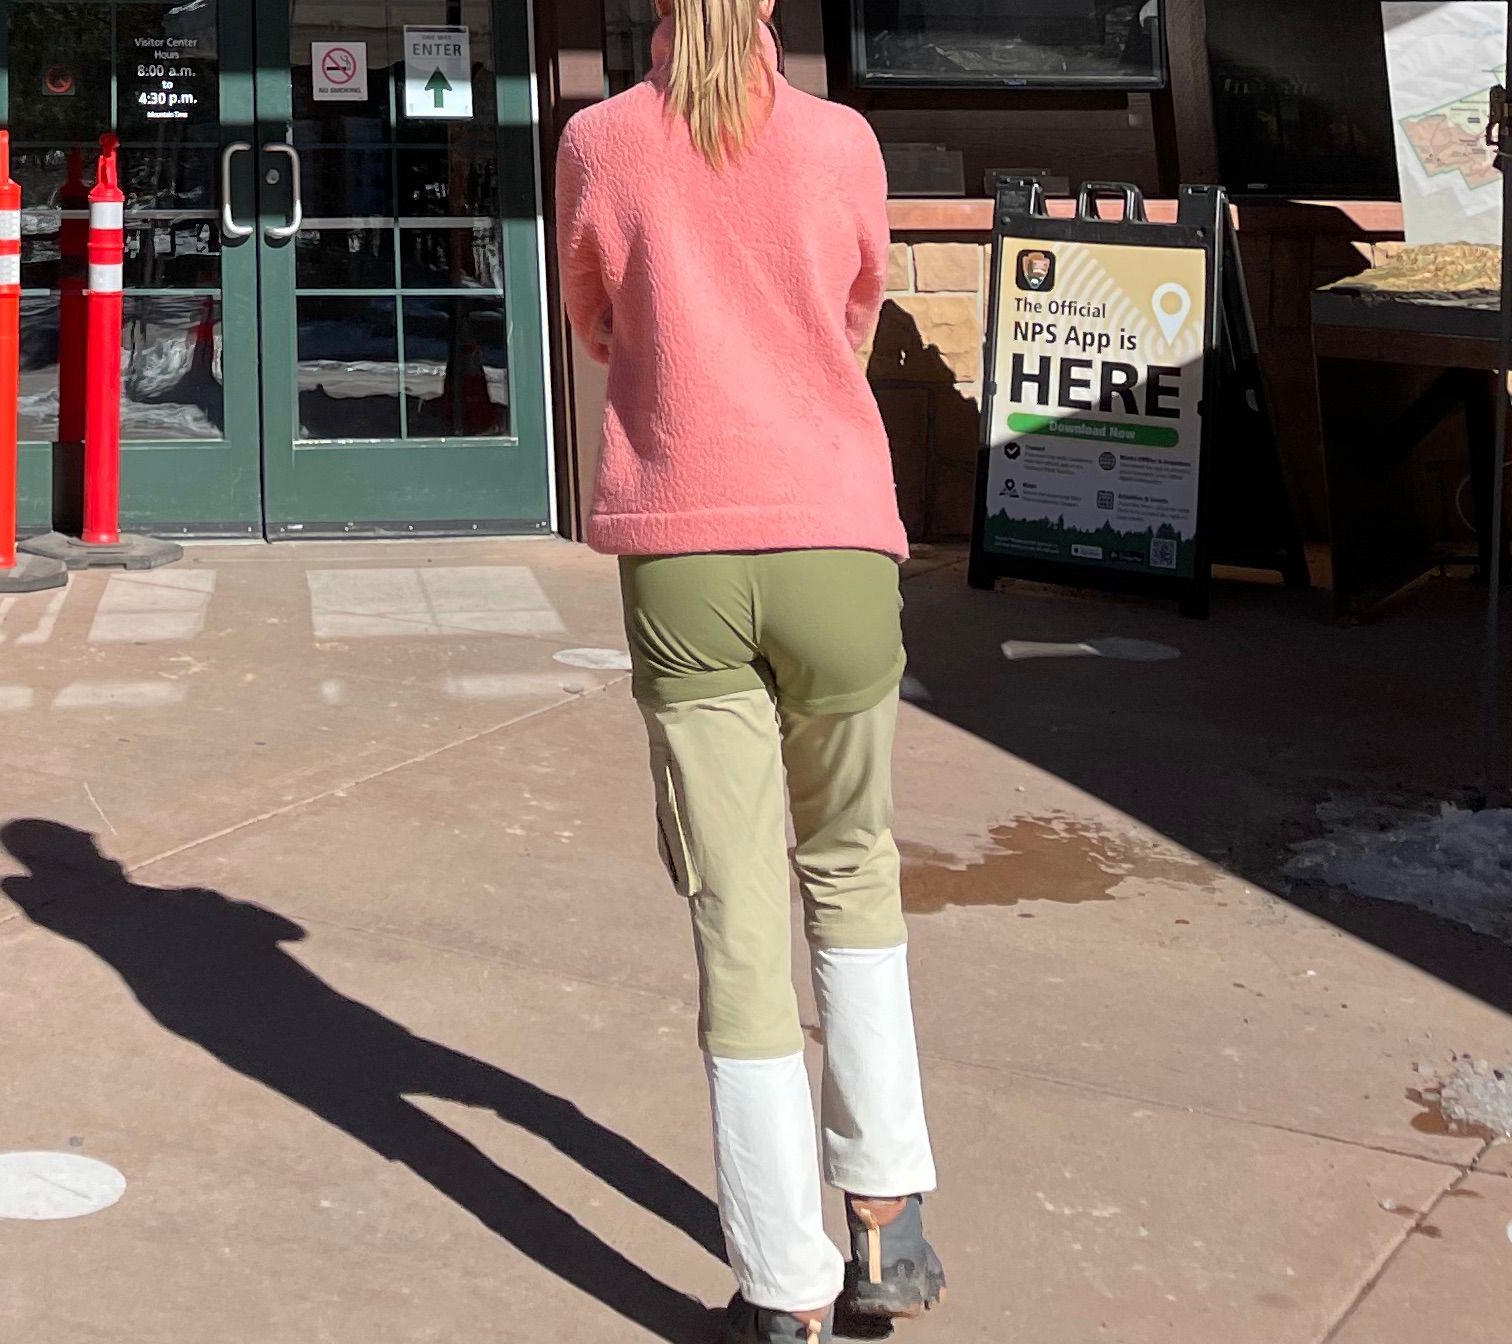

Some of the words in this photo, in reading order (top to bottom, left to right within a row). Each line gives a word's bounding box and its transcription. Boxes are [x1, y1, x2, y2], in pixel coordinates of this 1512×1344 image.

[134, 37, 164, 47] Visitor
[166, 37, 198, 47] Center
[154, 50, 180, 59] Hours
[413, 43, 462, 56] ENTER
[137, 64, 164, 77] 8:00
[168, 66, 196, 77] a.m.
[161, 80, 174, 89] to
[138, 92, 167, 105] 4:30
[168, 93, 198, 106] p.m.
[1015, 297, 1042, 313] The
[1048, 300, 1106, 318] Official
[1014, 321, 1057, 343] NPS
[1064, 326, 1111, 353] App
[1120, 328, 1137, 350] is
[1010, 353, 1182, 418] HERE
[1049, 420, 1107, 438] Download
[1109, 426, 1136, 439] Now
